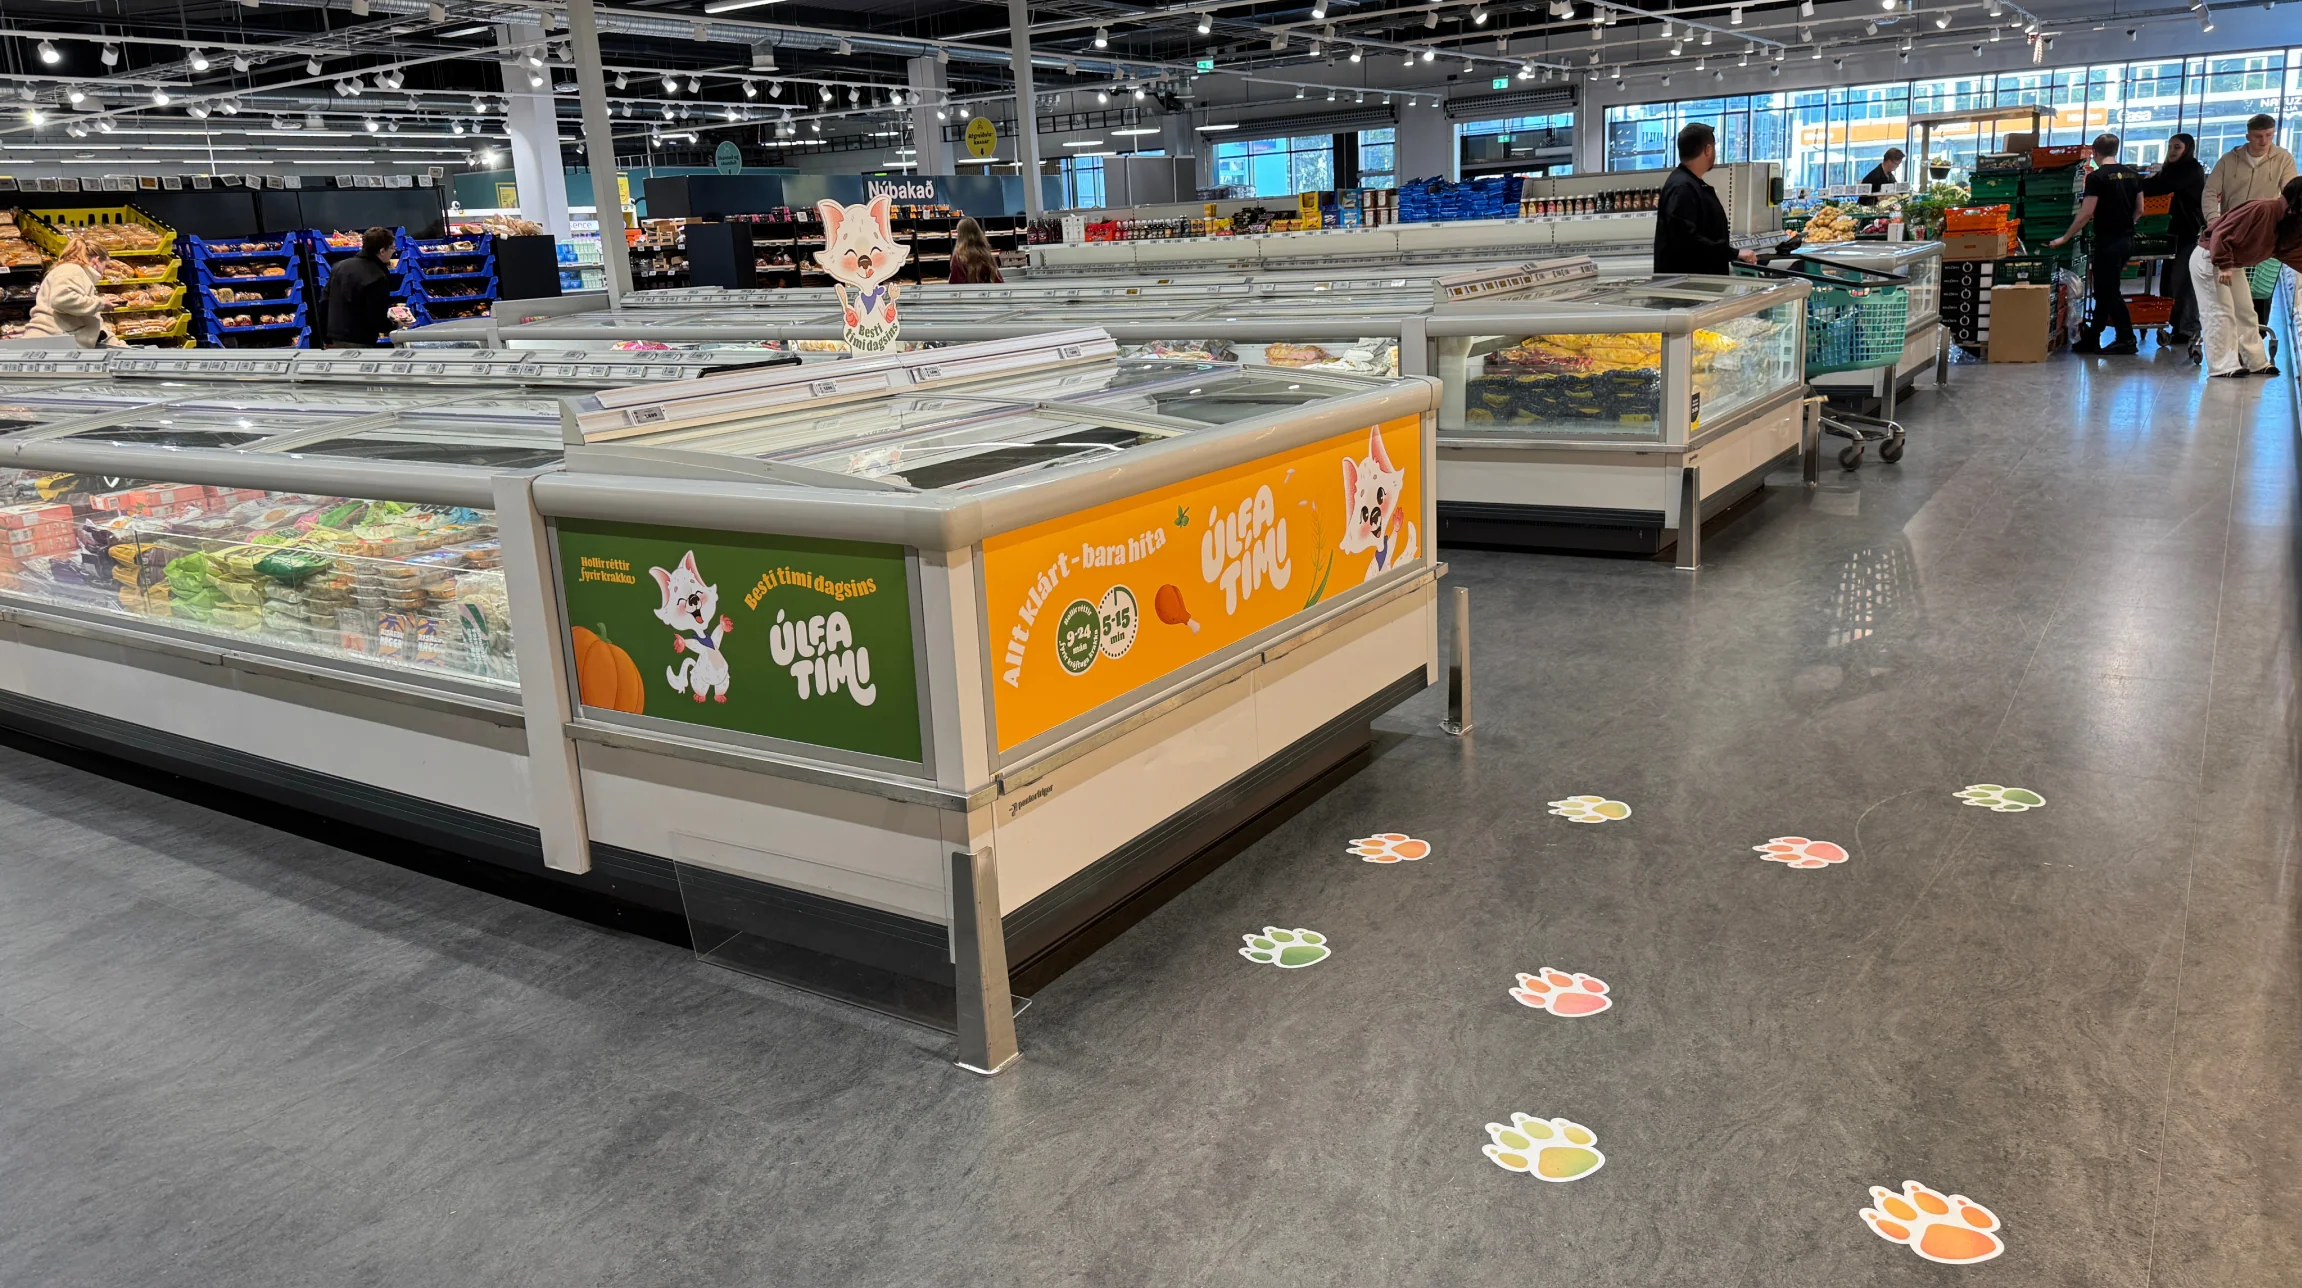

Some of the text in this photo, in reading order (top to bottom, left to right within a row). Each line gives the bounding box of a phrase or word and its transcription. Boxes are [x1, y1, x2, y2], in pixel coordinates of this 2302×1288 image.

[2260, 96, 2302, 108] NAUZ
[2273, 105, 2298, 114] ITLIA
[2116, 108, 2152, 124] Casa
[867, 179, 935, 200] Nýbakað
[858, 322, 883, 338] Besti
[866, 322, 899, 352] dagsins
[1201, 484, 1274, 583] ÚLFA
[579, 567, 636, 585] fyrir krakka
[580, 556, 630, 571] Hollir réttir
[1219, 517, 1291, 616] TÍMI
[744, 569, 778, 611] Besti
[814, 575, 877, 601] dagsins
[1003, 623, 1030, 688] Allt
[1018, 552, 1071, 627] klárt
[1082, 543, 1126, 569] bara
[1128, 527, 1167, 563] hita
[1102, 606, 1131, 636] 5-15
[769, 608, 853, 666] ÚLFA
[1066, 623, 1092, 648] 9-24
[790, 641, 877, 707] TÍMI
